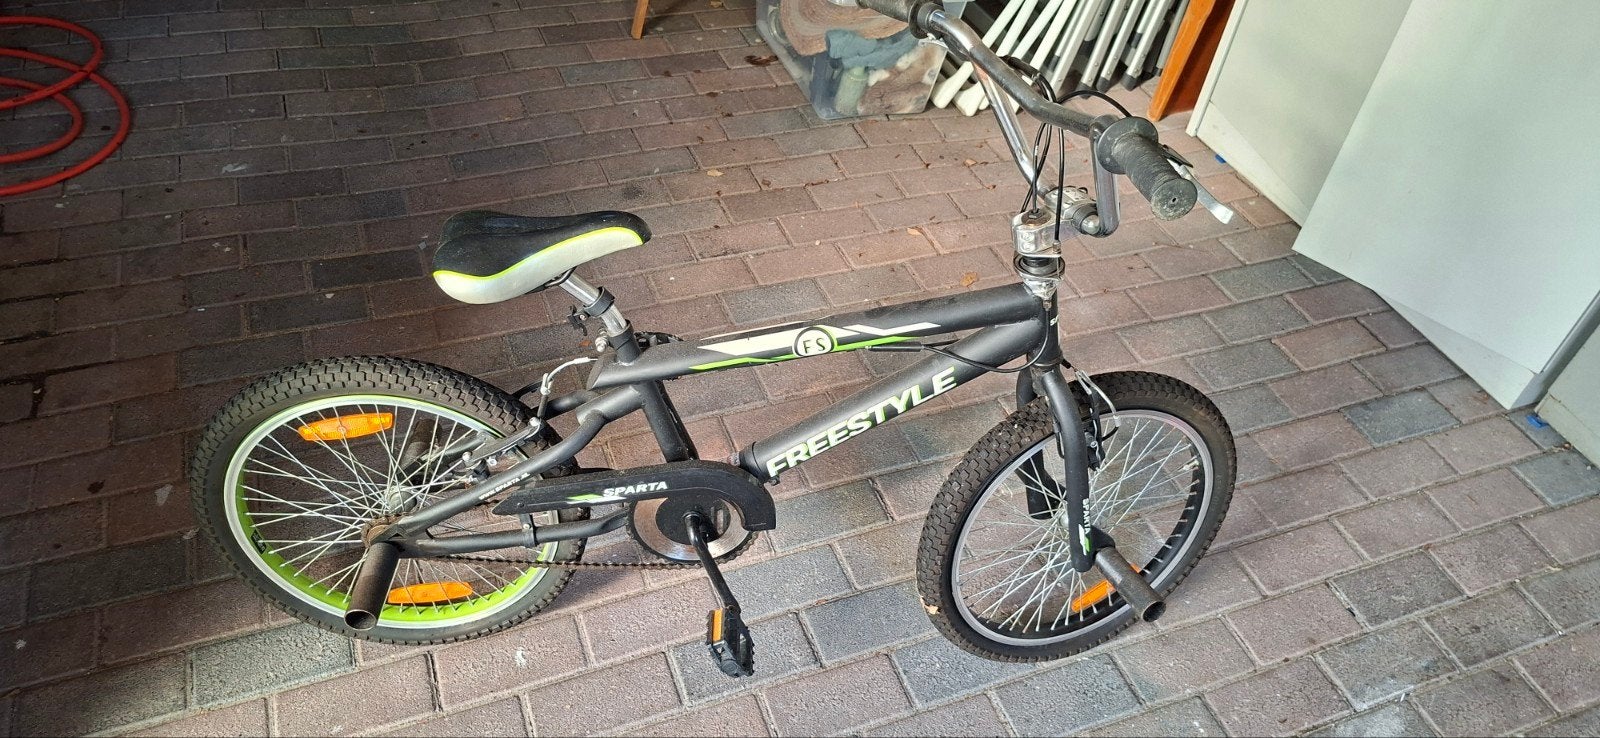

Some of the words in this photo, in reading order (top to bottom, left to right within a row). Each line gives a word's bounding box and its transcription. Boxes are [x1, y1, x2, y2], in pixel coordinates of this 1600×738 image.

[766, 366, 957, 477] FREESTYLE
[603, 481, 668, 497] SPARTA
[1082, 498, 1092, 535] SPARTA
